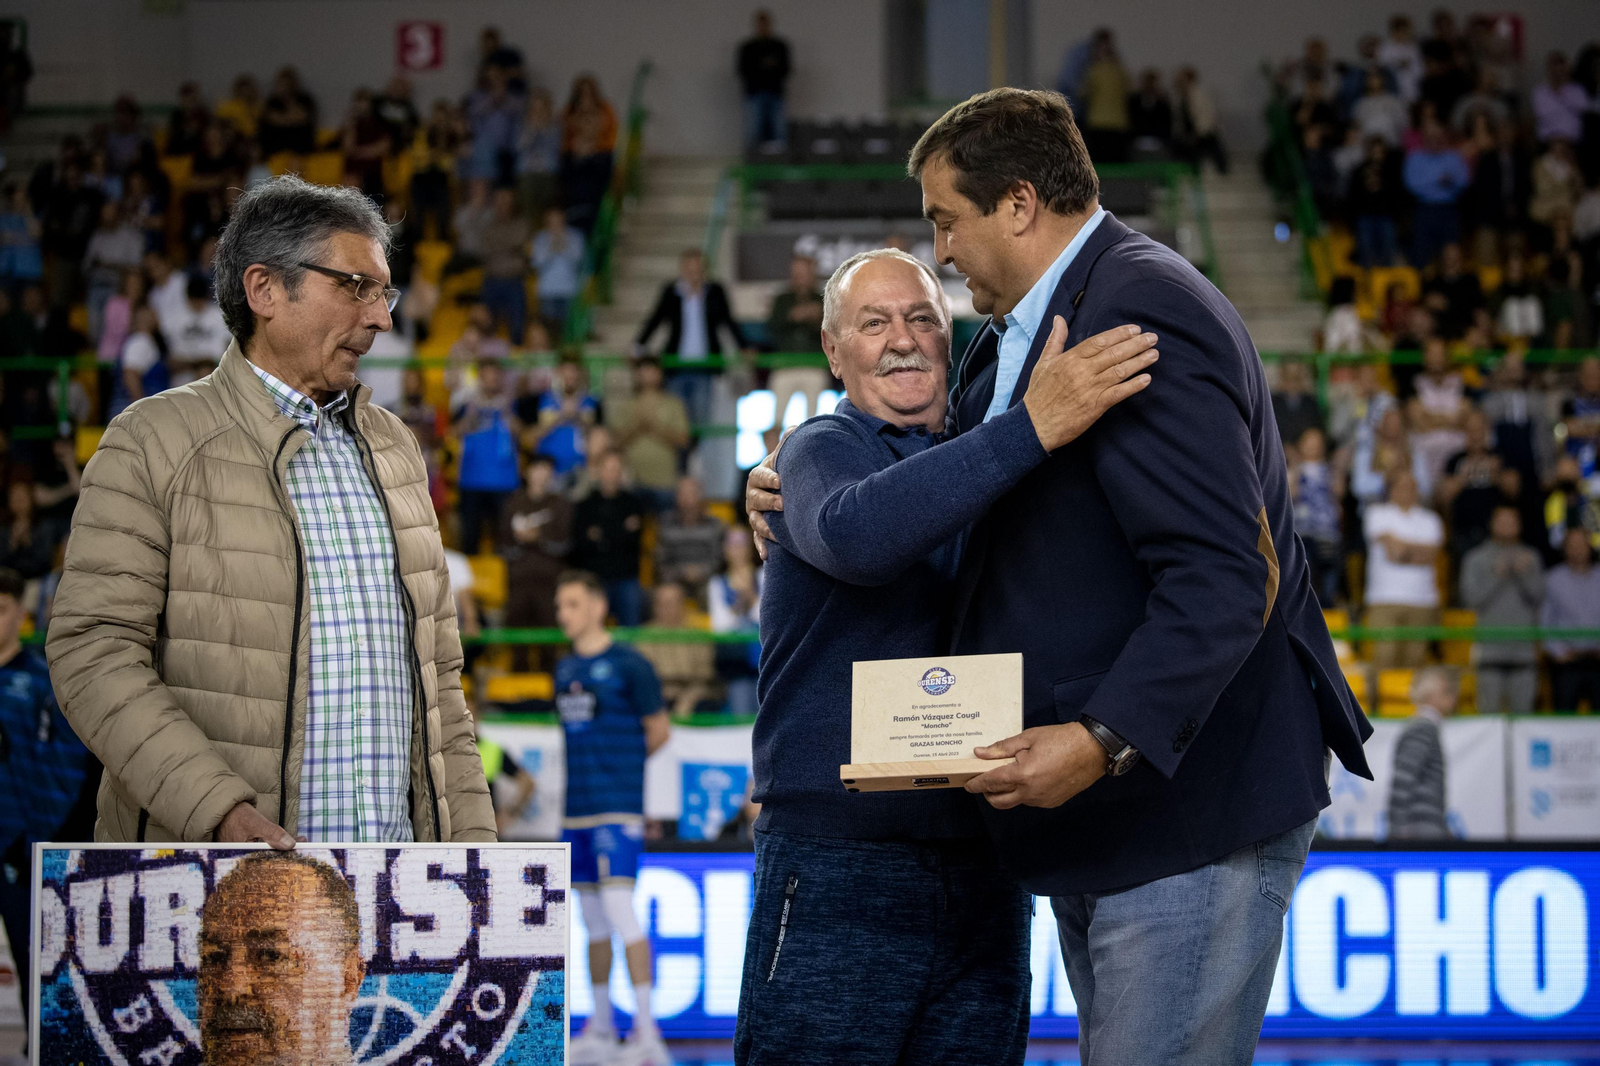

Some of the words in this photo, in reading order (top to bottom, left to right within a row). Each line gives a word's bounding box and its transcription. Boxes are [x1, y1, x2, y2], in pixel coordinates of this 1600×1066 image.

[407, 27, 434, 67] 3
[917, 675, 956, 687] OURENSE
[893, 714, 920, 723] Ramón
[921, 713, 954, 722] Vázquez
[956, 711, 980, 720] Cougil
